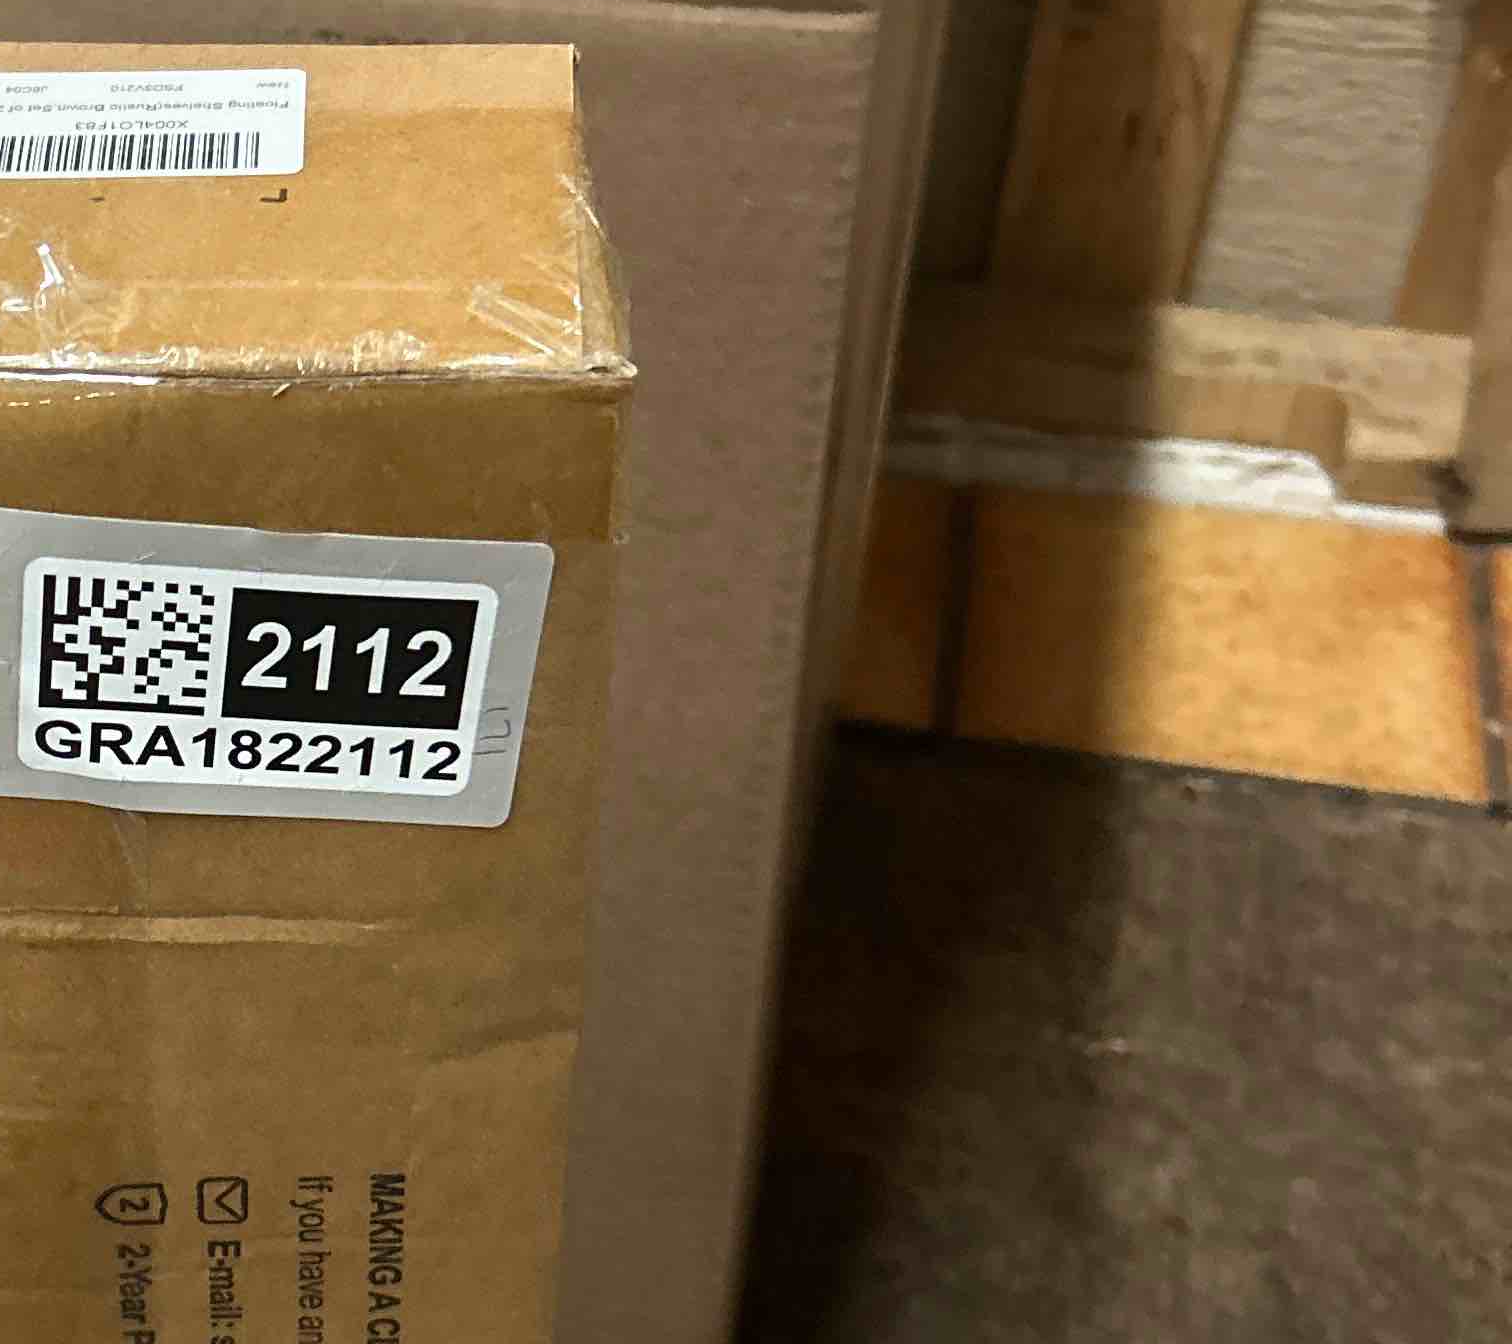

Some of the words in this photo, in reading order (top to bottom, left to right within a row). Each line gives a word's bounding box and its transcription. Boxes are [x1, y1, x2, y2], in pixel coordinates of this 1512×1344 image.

[240, 620, 455, 698] 2112
[34, 719, 462, 782] GRA1822112
[120, 1196, 150, 1213] 2
[298, 1175, 334, 1194] If
[289, 1197, 325, 1244] you
[366, 1173, 407, 1286] MAKING
[115, 1242, 153, 1324] 2-Year
[206, 1239, 243, 1328] E-mail:
[297, 1250, 333, 1311] have
[367, 1290, 402, 1313] A
